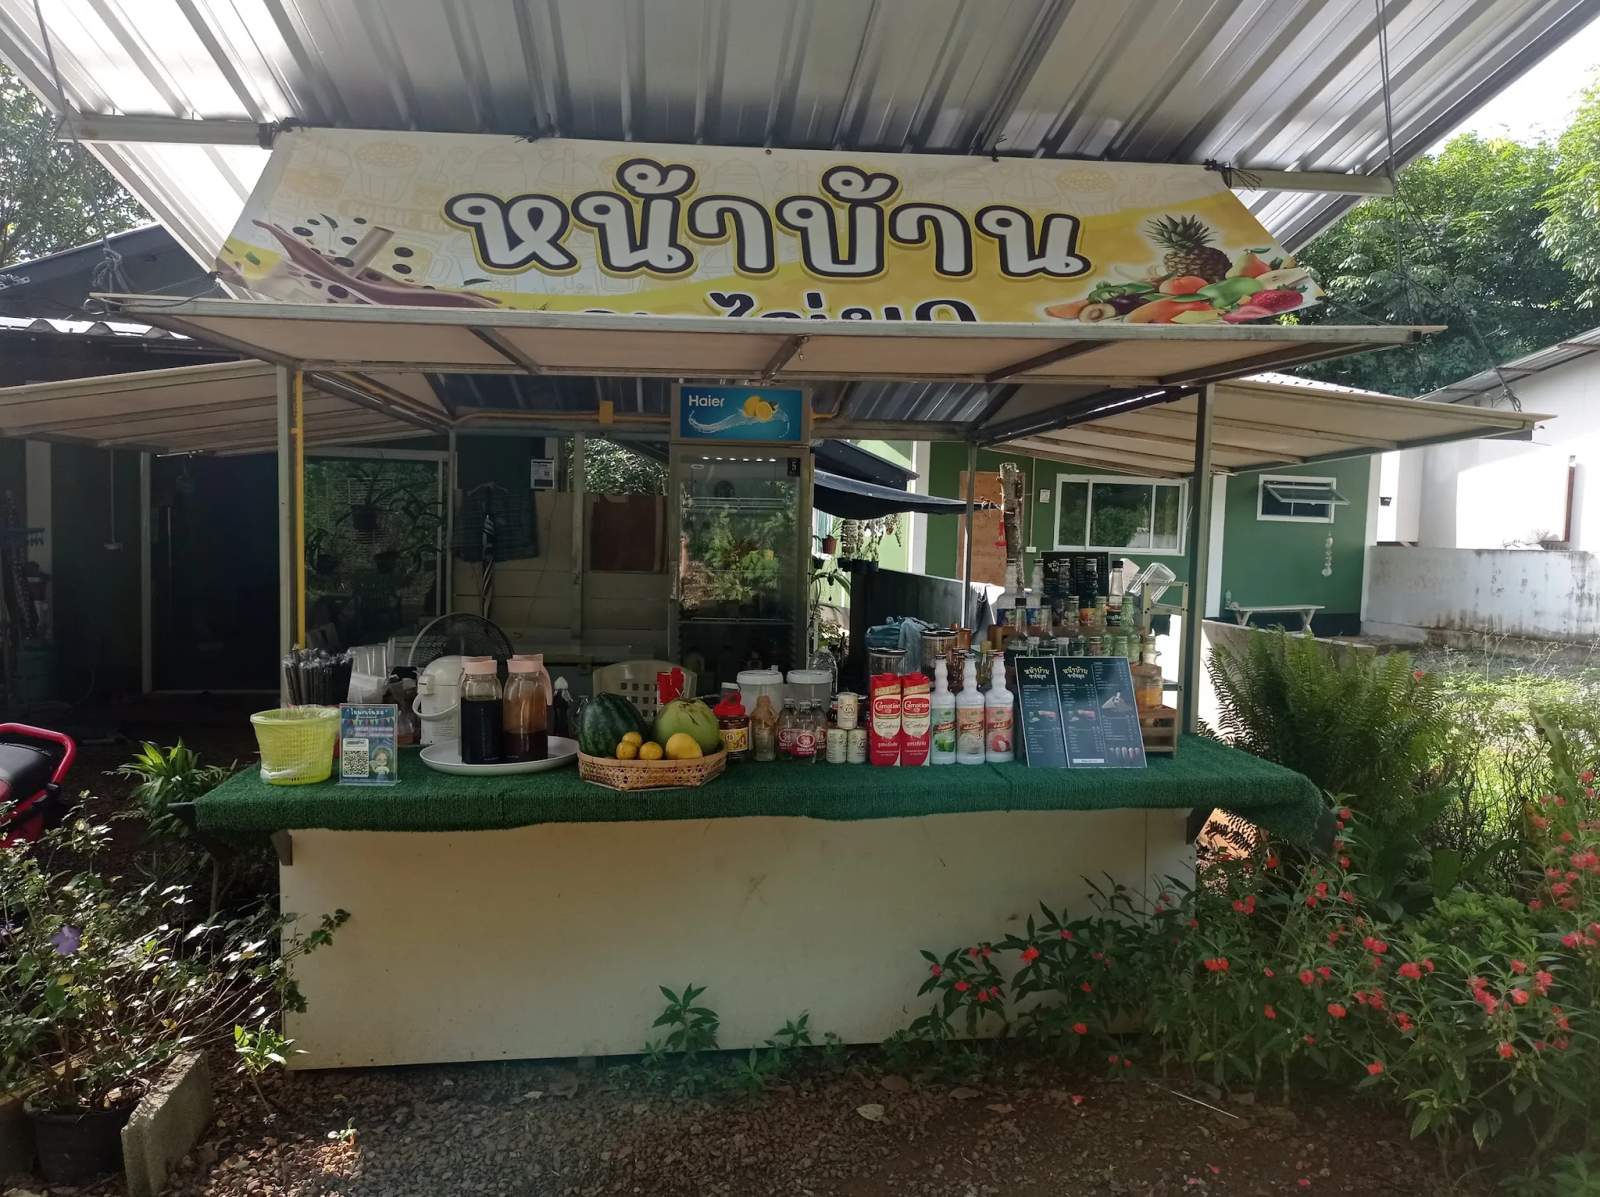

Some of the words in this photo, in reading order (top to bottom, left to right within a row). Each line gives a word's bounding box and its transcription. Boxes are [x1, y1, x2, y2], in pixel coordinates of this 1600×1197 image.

[444, 157, 1091, 277] หน้าบ้าน
[688, 394, 726, 408] Haier
